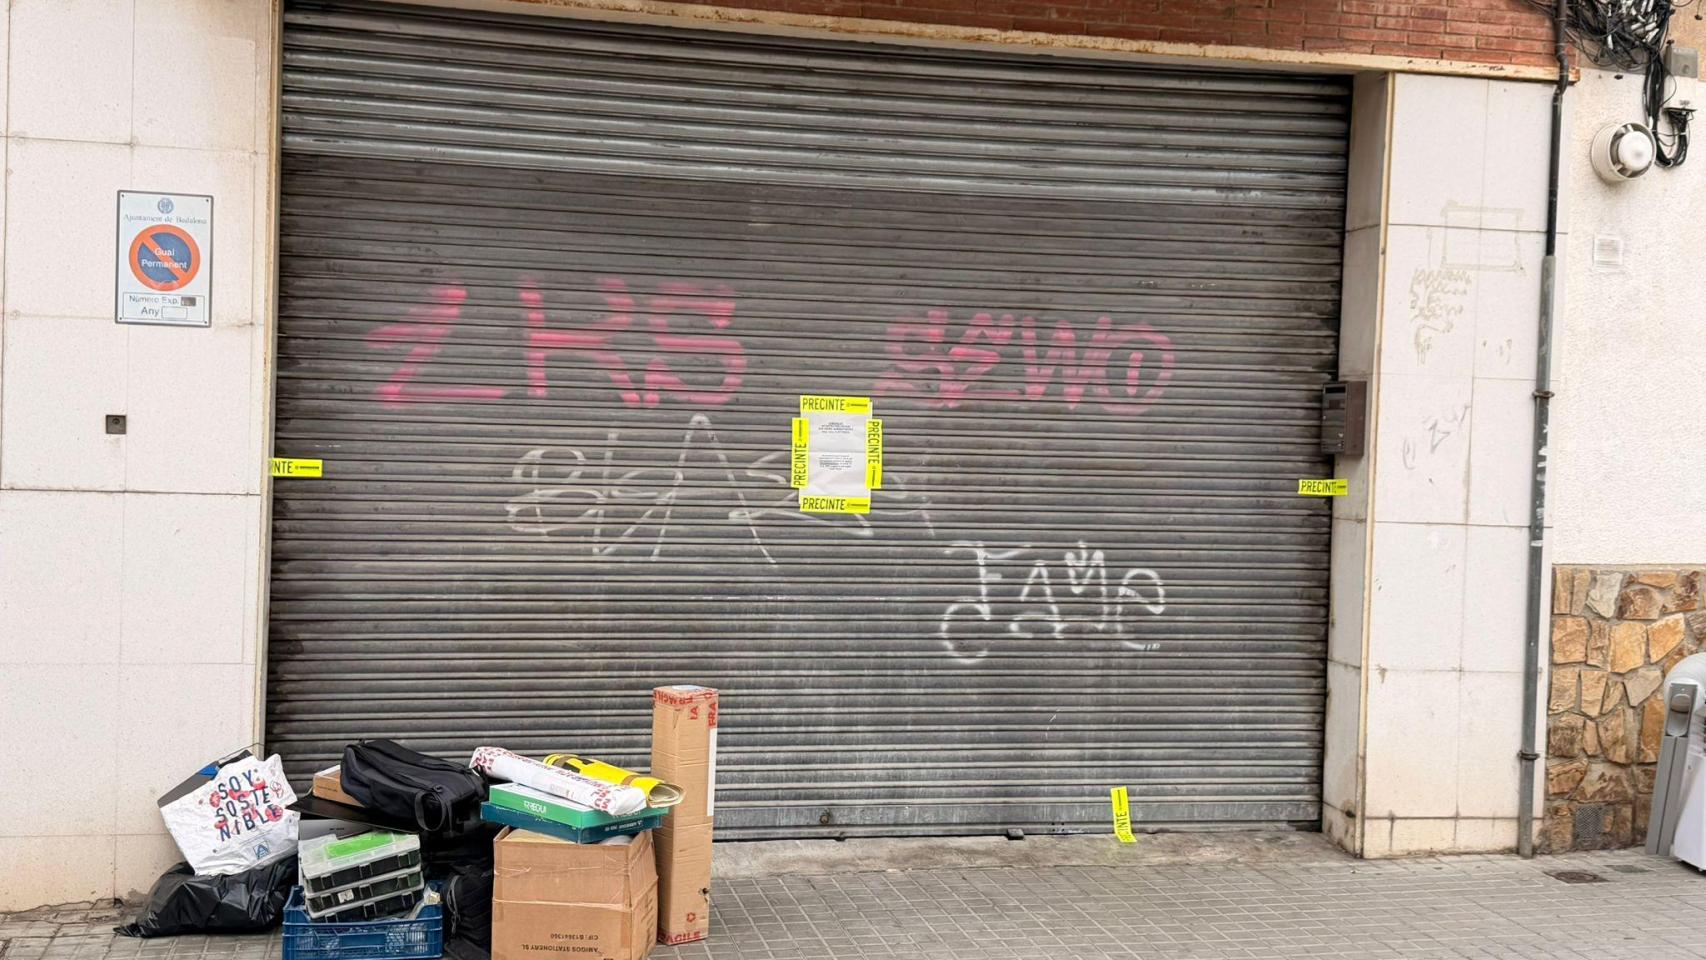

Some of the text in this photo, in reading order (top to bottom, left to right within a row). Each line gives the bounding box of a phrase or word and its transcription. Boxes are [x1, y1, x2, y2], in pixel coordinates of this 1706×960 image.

[154, 248, 175, 256] Gual
[141, 259, 187, 269] Permanent
[141, 306, 159, 317] Any
[802, 397, 846, 411] PRECINTE
[867, 420, 880, 465] PRECINTE
[272, 460, 293, 474] NTE
[794, 442, 807, 486] PRECINTE
[802, 497, 846, 511] PRECINTE
[218, 769, 253, 800] SOY
[215, 786, 271, 824] SOSTE
[219, 803, 283, 841] NIBLE
[530, 944, 571, 953] STATIONERY
